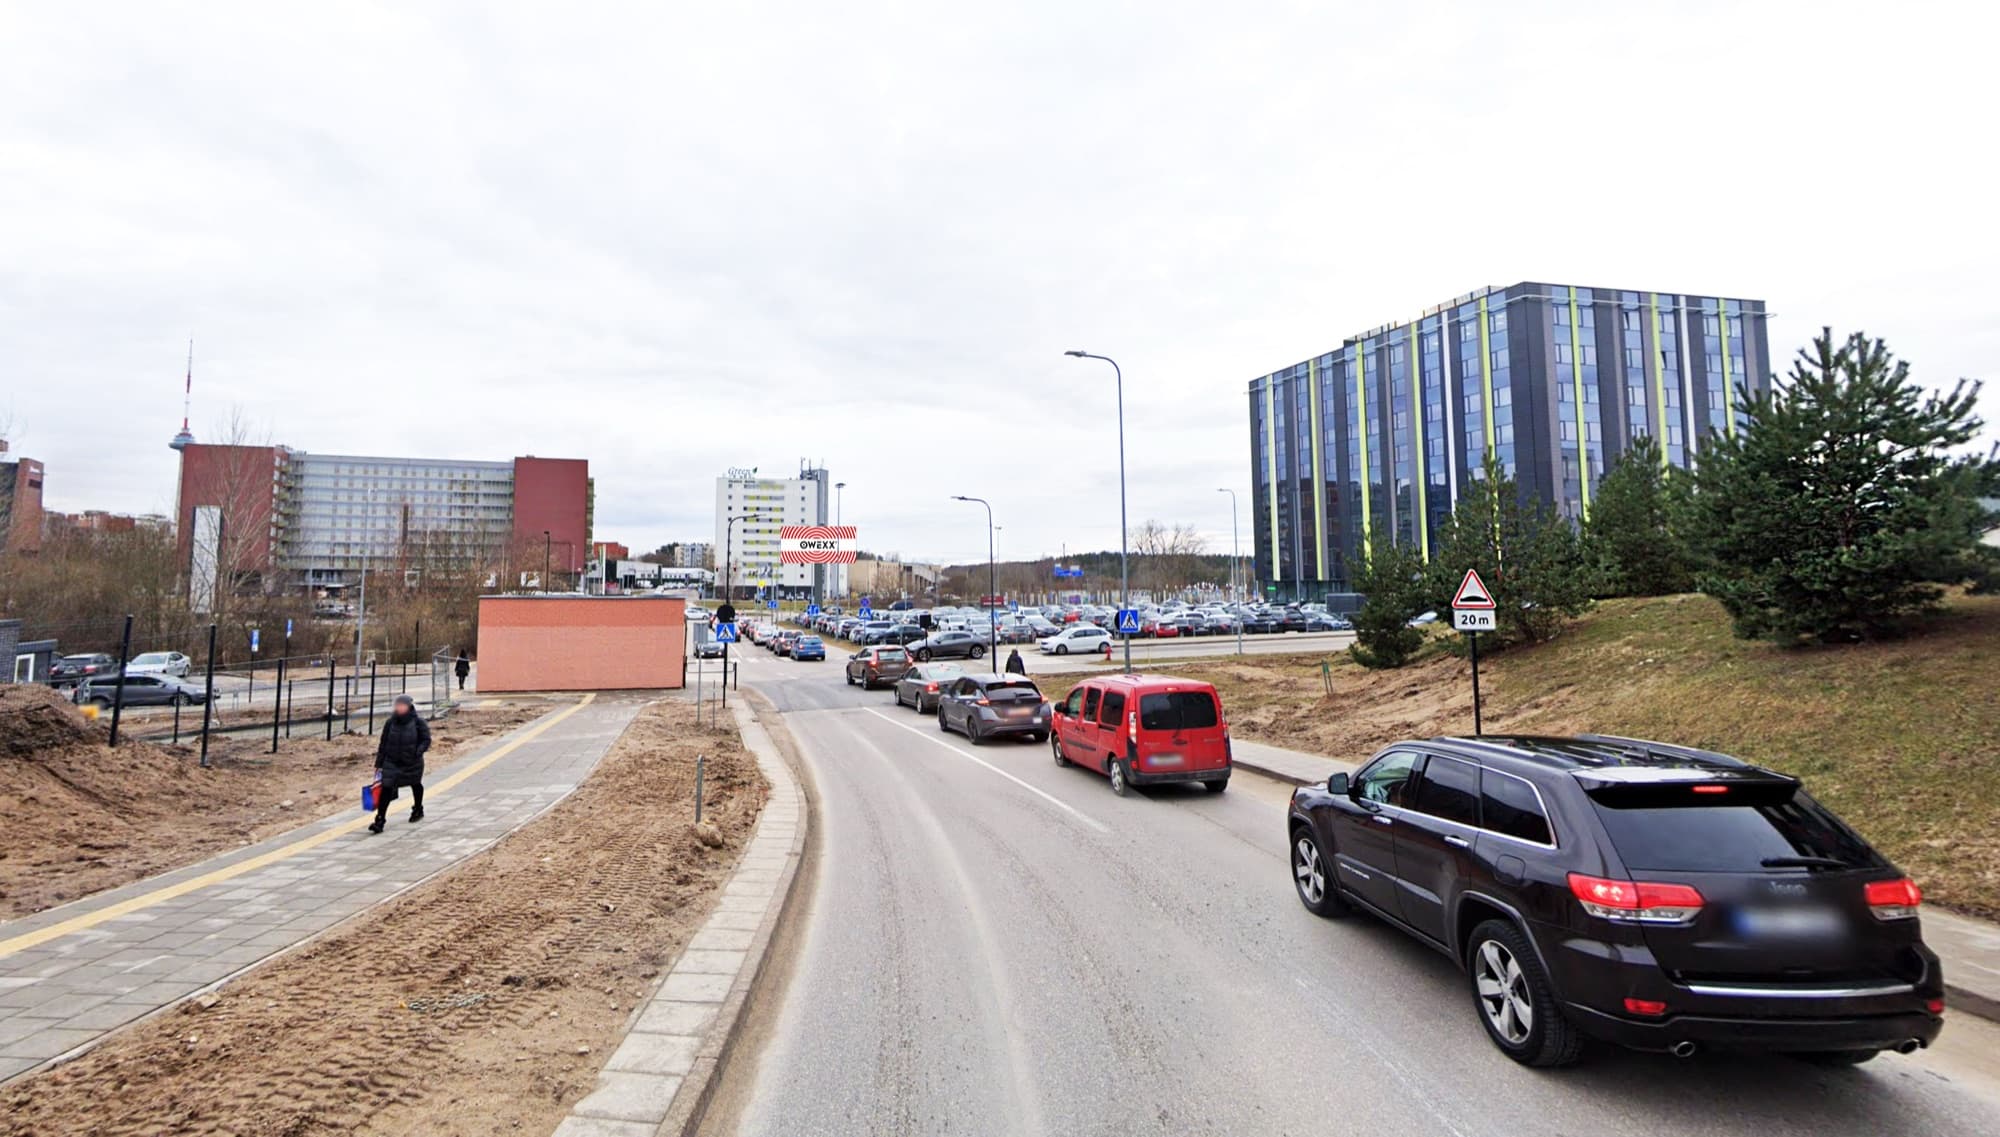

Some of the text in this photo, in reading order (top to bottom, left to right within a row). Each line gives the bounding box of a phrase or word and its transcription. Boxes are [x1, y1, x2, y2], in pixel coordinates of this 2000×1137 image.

[800, 541, 835, 549] OWEXX
[1461, 614, 1489, 625] 20 m
